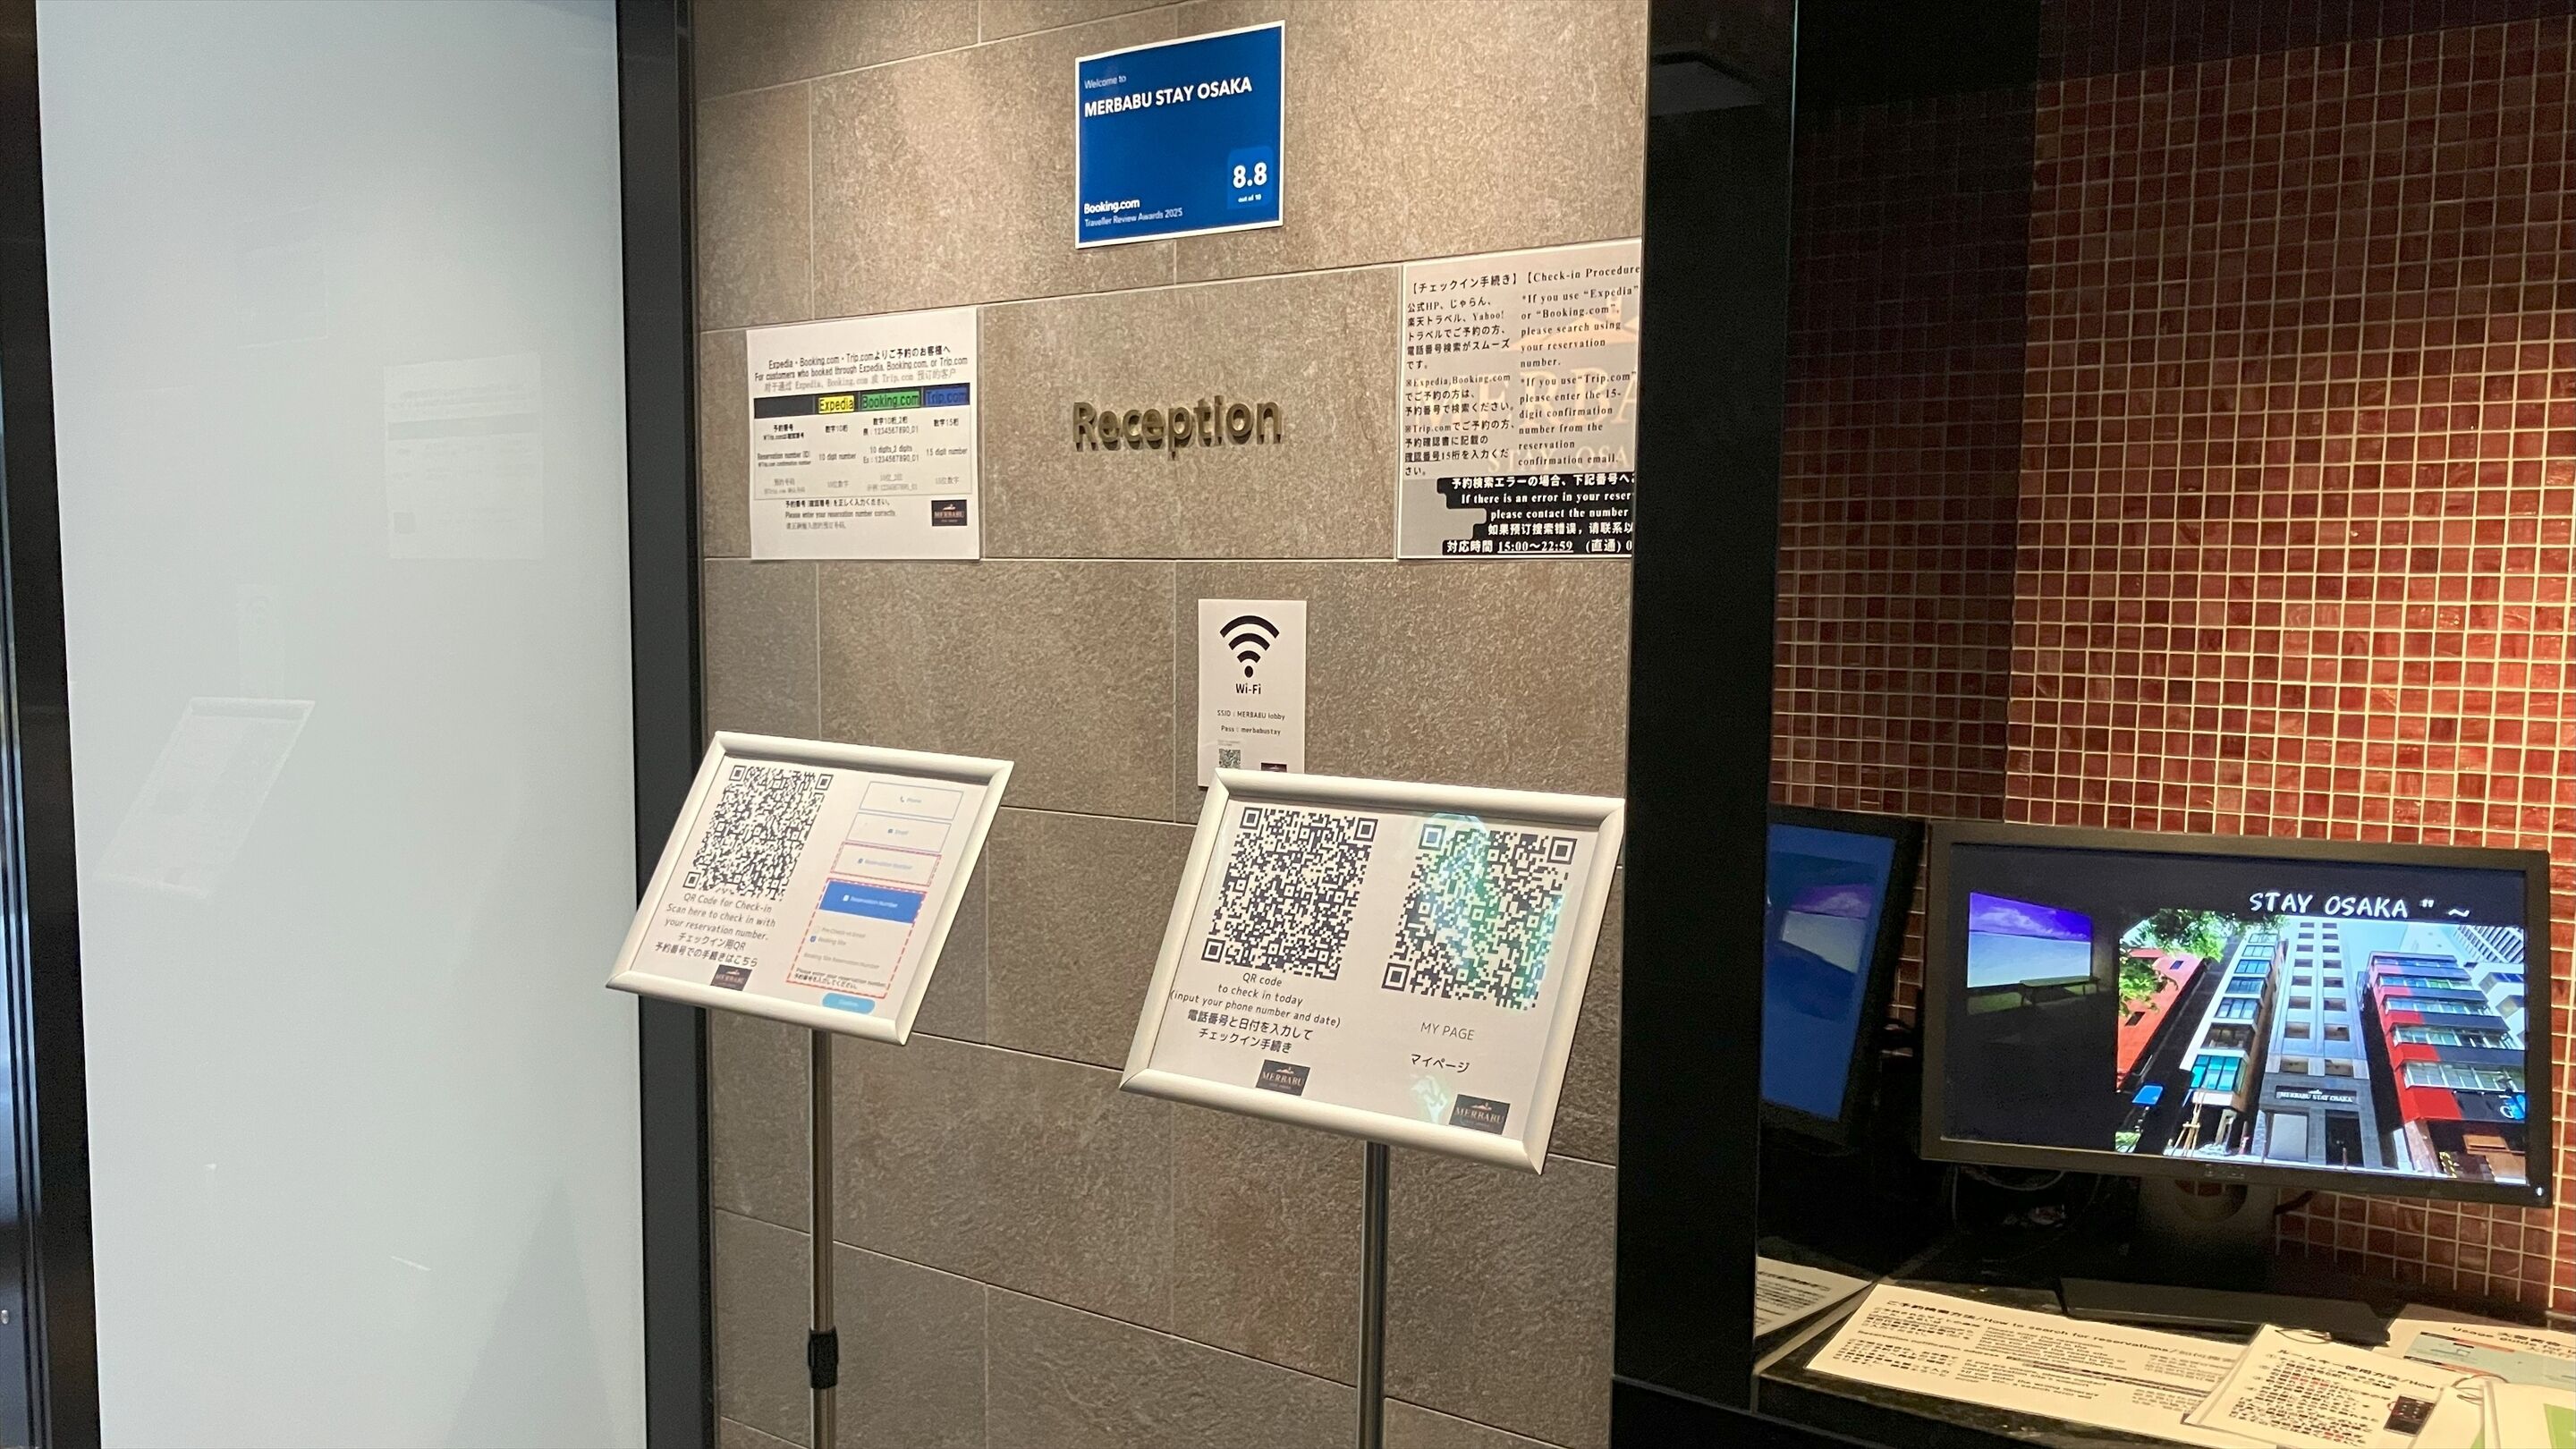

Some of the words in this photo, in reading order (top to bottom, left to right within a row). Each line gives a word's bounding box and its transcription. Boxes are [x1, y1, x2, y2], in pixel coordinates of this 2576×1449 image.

[1084, 76, 1117, 89] Welcome
[1084, 91, 1152, 117] MERBABU
[1156, 86, 1194, 106] STAY
[1198, 76, 1252, 99] OSAKA
[1233, 162, 1267, 188] 8.8
[1084, 199, 1140, 214] Booking.com
[1085, 217, 1112, 227] Traveller
[1114, 215, 1136, 224] Review
[1139, 211, 1163, 221] Awards
[1165, 208, 1182, 218] 2025
[1586, 266, 1640, 277] Procedure
[1541, 295, 1558, 305] you
[1563, 292, 1579, 301] use
[1521, 312, 1531, 320] or
[1521, 326, 1553, 338] please
[1556, 323, 1589, 334] search
[1594, 321, 1622, 331] using
[1521, 343, 1543, 353] your
[1547, 338, 1606, 350] reservation
[755, 372, 764, 381] For
[767, 371, 795, 380] customers
[798, 369, 809, 377] who
[811, 368, 833, 377] booked
[835, 366, 857, 376] through
[931, 359, 937, 367] or
[940, 357, 968, 367] Trip.com
[1521, 359, 1561, 368] number.
[1539, 378, 1556, 387] you
[818, 398, 853, 412] Expedia
[862, 394, 919, 409] Booking.com
[927, 390, 966, 405] Trip.com
[1520, 394, 1551, 405] please
[1555, 393, 1580, 402] enter
[1585, 391, 1601, 399] the
[1606, 388, 1622, 399] 15-
[1519, 410, 1543, 420] digit
[1546, 405, 1614, 418] confirmation
[1072, 395, 1282, 460] Reception
[1519, 425, 1555, 435] number
[1559, 424, 1583, 433] from
[1588, 422, 1603, 431] the
[1518, 440, 1575, 450] reservation
[1518, 455, 1583, 466] confirmation
[1587, 453, 1619, 464] email.
[1462, 494, 1470, 504] If
[1474, 494, 1499, 504] there
[1504, 493, 1512, 503] is
[1515, 494, 1528, 503] an
[1530, 494, 1558, 503] error
[1563, 492, 1572, 502] in
[1576, 493, 1600, 504] your
[1604, 492, 1633, 502] reser
[1490, 510, 1522, 521] please
[1526, 509, 1564, 519] contact
[1569, 508, 1585, 518] the
[1589, 507, 1629, 517] number
[1446, 539, 1493, 554] 対応時間
[1235, 682, 1262, 695] Wi-Fi
[683, 893, 696, 902] QR
[698, 894, 717, 905] Code
[720, 898, 733, 908] for
[735, 900, 772, 912] Check-in
[2249, 892, 2313, 913] STAY
[2324, 895, 2408, 918] OSAKA
[666, 903, 687, 914] Scan
[688, 906, 707, 918] here
[709, 911, 718, 919] to
[719, 912, 743, 923] check
[745, 915, 754, 924] in
[756, 917, 776, 928] with
[664, 918, 683, 928] your
[685, 919, 733, 936] reservation
[1242, 972, 1257, 983] QR
[1259, 974, 1283, 987] code
[1218, 984, 1228, 994] to
[1231, 987, 1259, 998] check
[1262, 990, 1271, 1000] in
[1275, 993, 1303, 1007] today
[1170, 989, 1199, 1004] (input
[1202, 997, 1224, 1008] your
[1224, 999, 1254, 1013] phone
[1256, 1004, 1291, 1018] number
[1293, 1011, 1311, 1021] and
[1313, 1013, 1342, 1028] date)
[1187, 1008, 1313, 1041] 電話番号と日付を入力して
[1420, 1021, 1440, 1034] MY
[1442, 1025, 1475, 1041] PAGE
[1199, 1028, 1292, 1054] チェックイン手続き
[1411, 1053, 1470, 1073] マイページ
[1261, 1071, 1304, 1087] MERBABU
[1454, 1106, 1504, 1123] MERBABU
